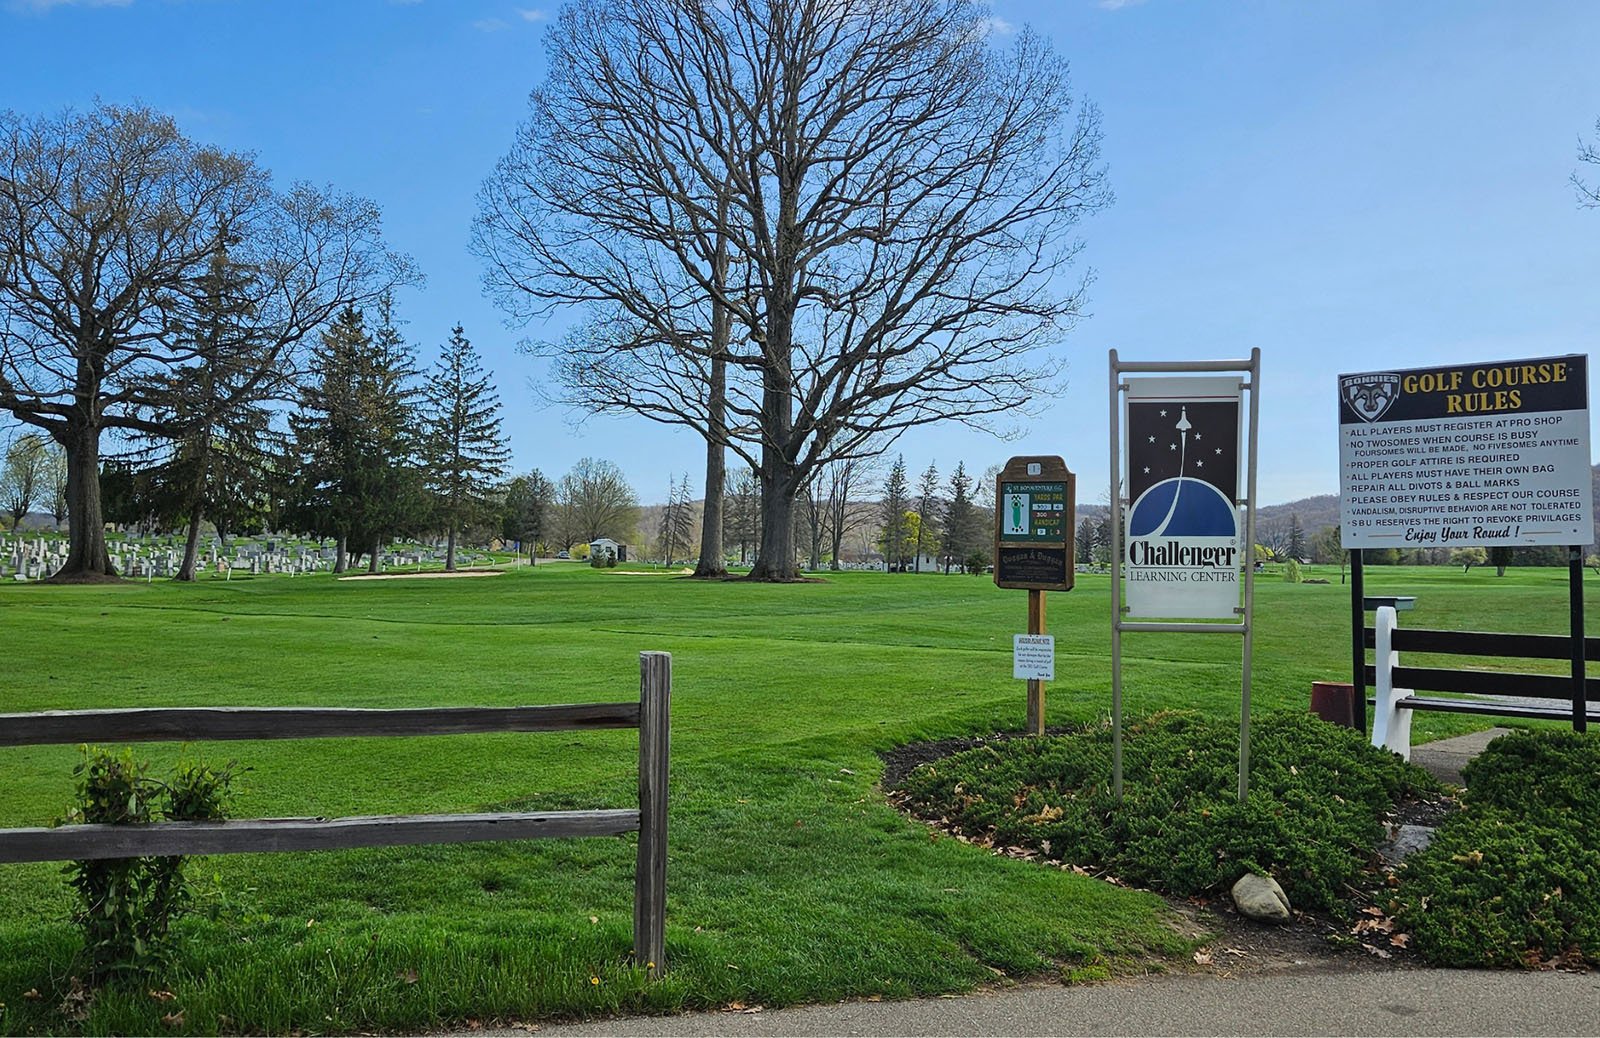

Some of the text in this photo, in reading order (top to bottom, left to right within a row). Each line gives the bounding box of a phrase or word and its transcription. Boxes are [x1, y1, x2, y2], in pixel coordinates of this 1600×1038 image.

[1343, 375, 1398, 388] BONNIES
[1403, 363, 1567, 394] GOLF COURSE
[1446, 390, 1522, 414] RULES
[1370, 426, 1412, 436] PLAYERS
[1416, 424, 1441, 433] MUST
[1444, 421, 1492, 431] REGISTER
[1496, 420, 1507, 428] AT
[1510, 418, 1531, 427] PRO
[1534, 416, 1563, 426] SHOP
[1366, 437, 1420, 448] TWOSOMES
[1422, 436, 1452, 444] WHEN
[1454, 433, 1495, 443] COURSE
[1498, 432, 1508, 440] IS
[1511, 430, 1538, 440] BUSY
[1355, 448, 1405, 457] FOURSOMES
[1488, 441, 1537, 450] FIVESOMES
[1540, 438, 1579, 447] ANYTIME
[1351, 454, 1520, 469] PROPER GOLF ATTIRE IS REQUIRED
[1372, 471, 1413, 480] PLAYERS
[1416, 470, 1442, 478] MUST
[1444, 469, 1470, 477] HAVE
[1473, 467, 1502, 476] THEIR
[1506, 466, 1529, 474] OWN
[1532, 464, 1555, 473] BAG
[1352, 484, 1385, 492] REPAIR
[1409, 482, 1442, 490] DIVOTS
[1456, 480, 1480, 489] BALL
[1484, 479, 1520, 487] MARKS
[1352, 496, 1388, 504] PLEASE
[1390, 495, 1416, 503] OBEY
[1419, 494, 1450, 502] RULES
[1463, 491, 1509, 500] RESPECT
[1512, 490, 1534, 499] OUR
[1536, 489, 1580, 498] COURSE
[1400, 506, 1446, 514] DISRUPTIVE
[1448, 504, 1489, 513] BEHAVIOR
[1531, 502, 1581, 510] TOLERATED
[1486, 515, 1523, 524] REVOKE
[1526, 514, 1582, 522] PRIVILAGES
[1405, 525, 1520, 543] Enjoy Your Round !
[1130, 541, 1236, 569] Challenger
[1130, 572, 1235, 582] LEARNING CENTER
